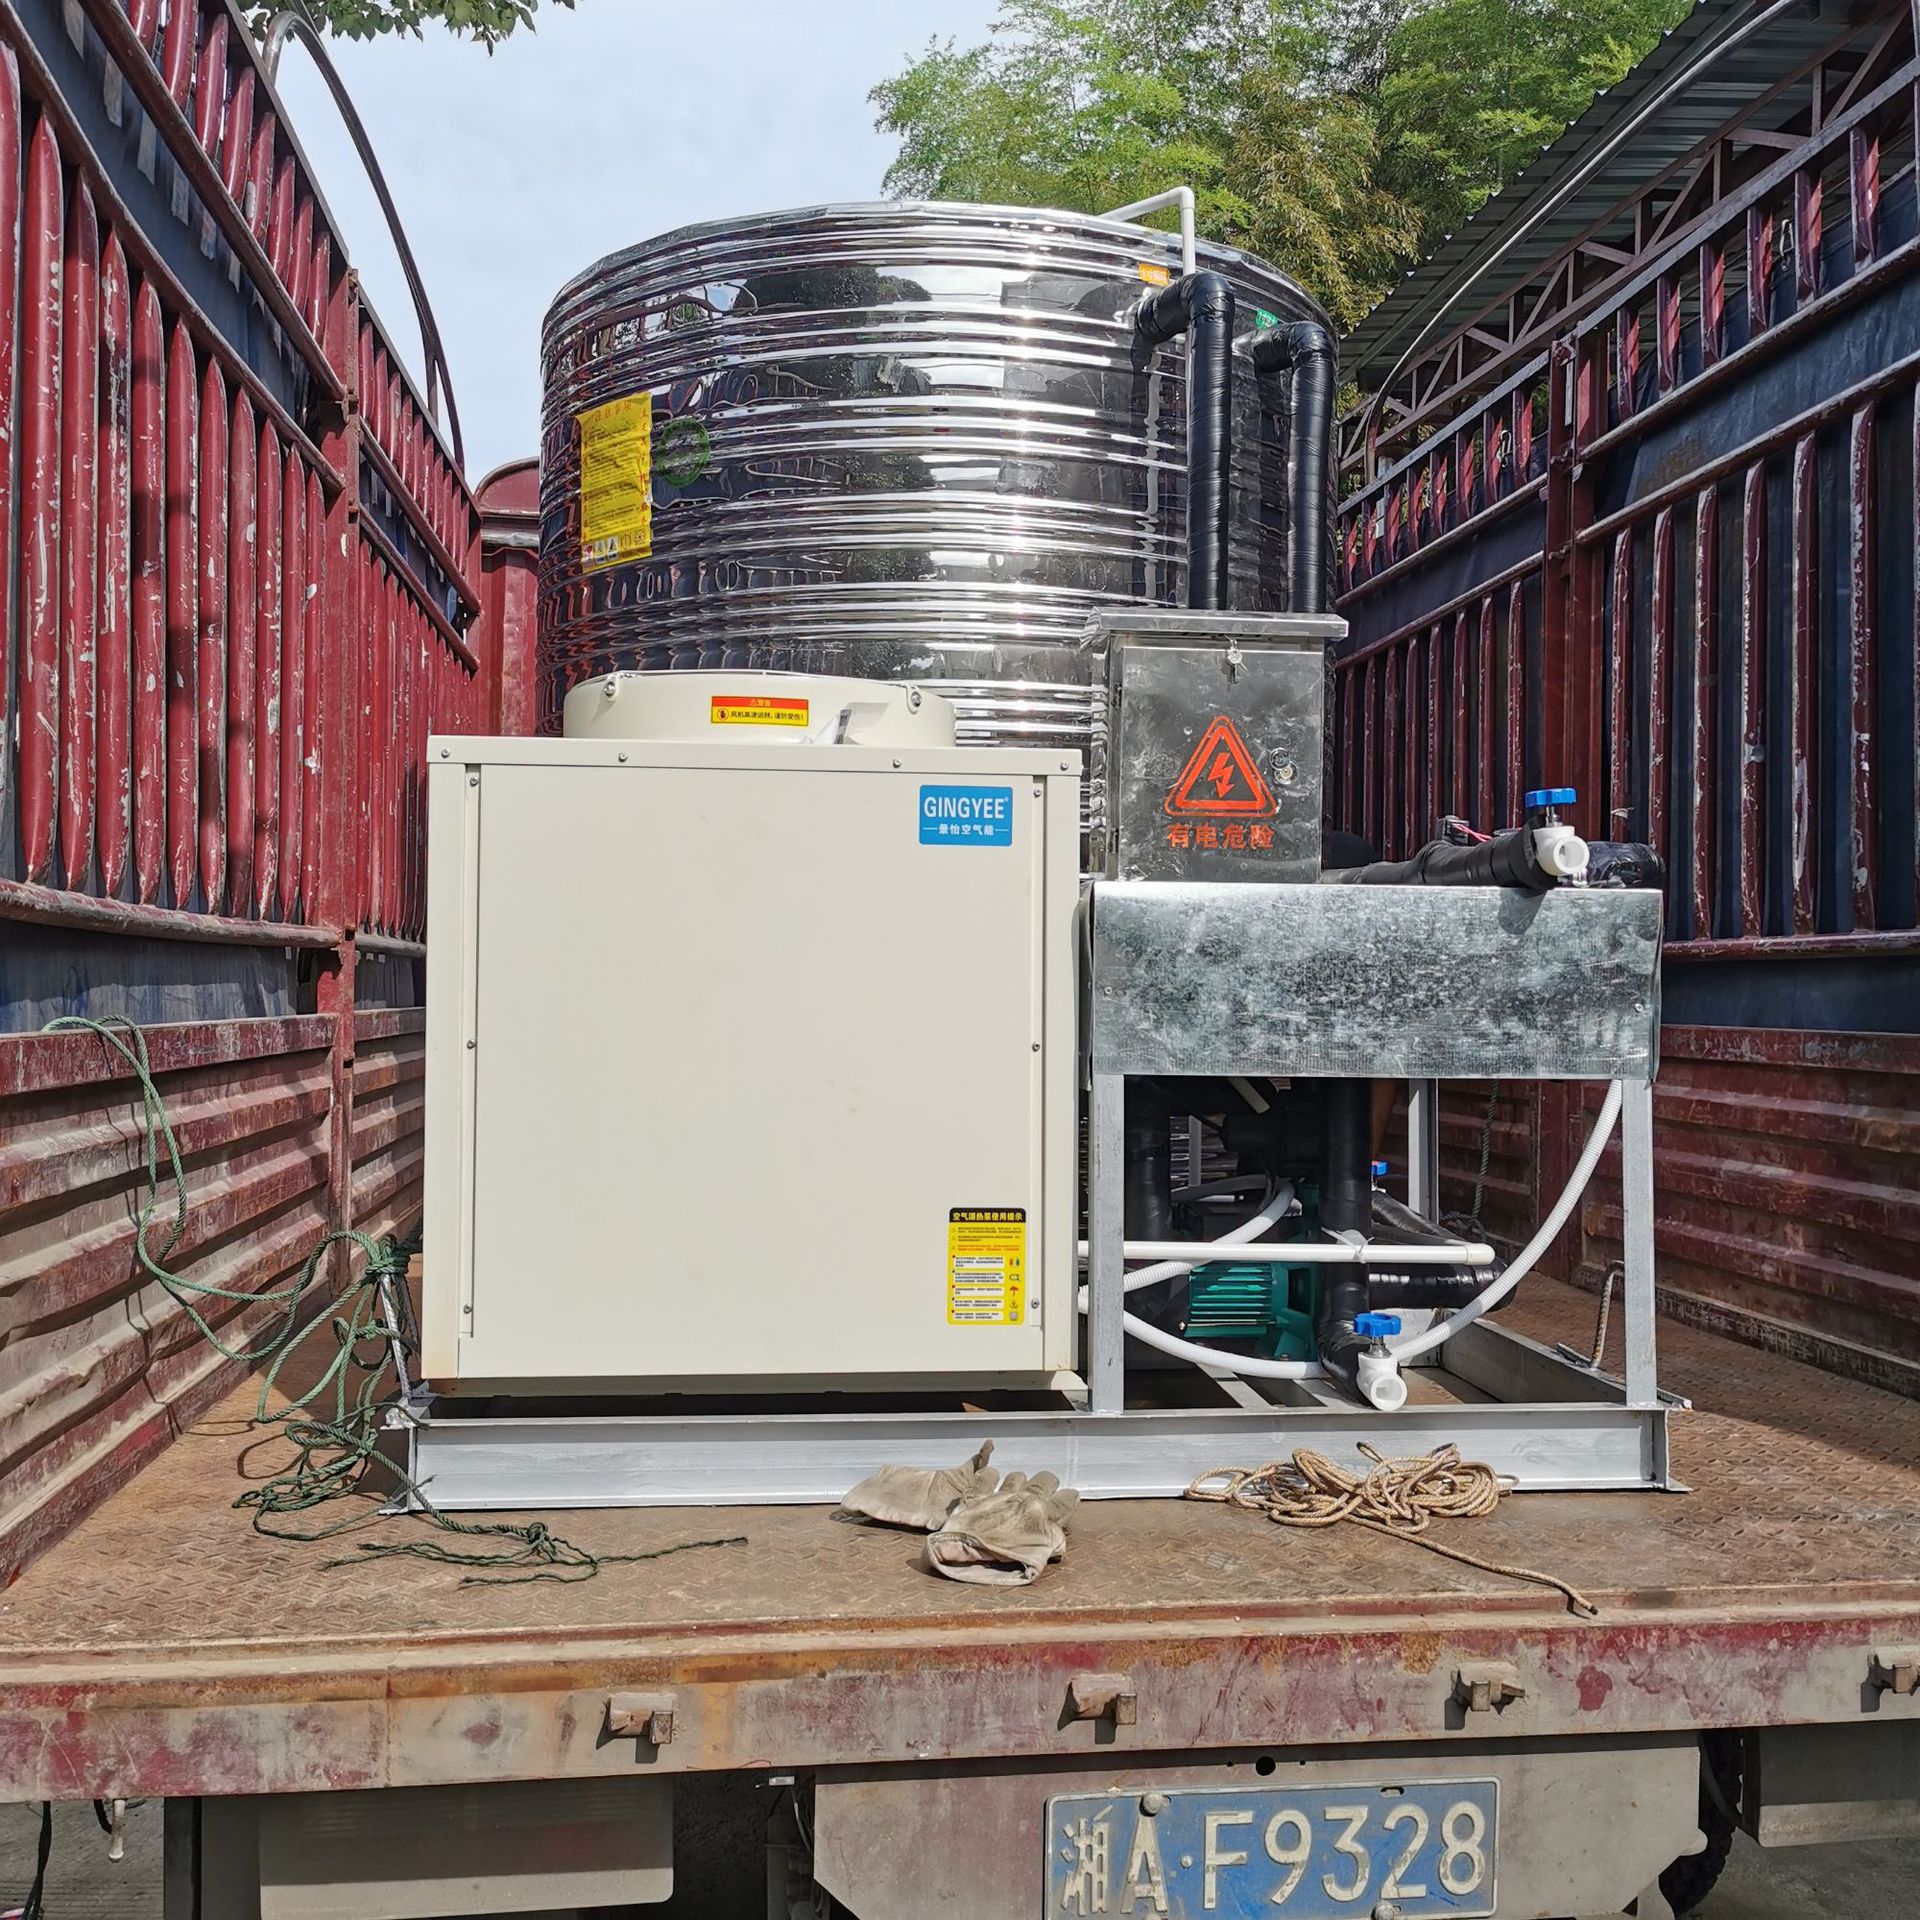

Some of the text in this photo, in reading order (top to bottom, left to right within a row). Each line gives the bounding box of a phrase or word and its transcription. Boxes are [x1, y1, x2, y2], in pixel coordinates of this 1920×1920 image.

[924, 796, 1005, 819] GINGYEE
[938, 823, 994, 836] 景怡空气能
[1167, 823, 1275, 849] 有电危险
